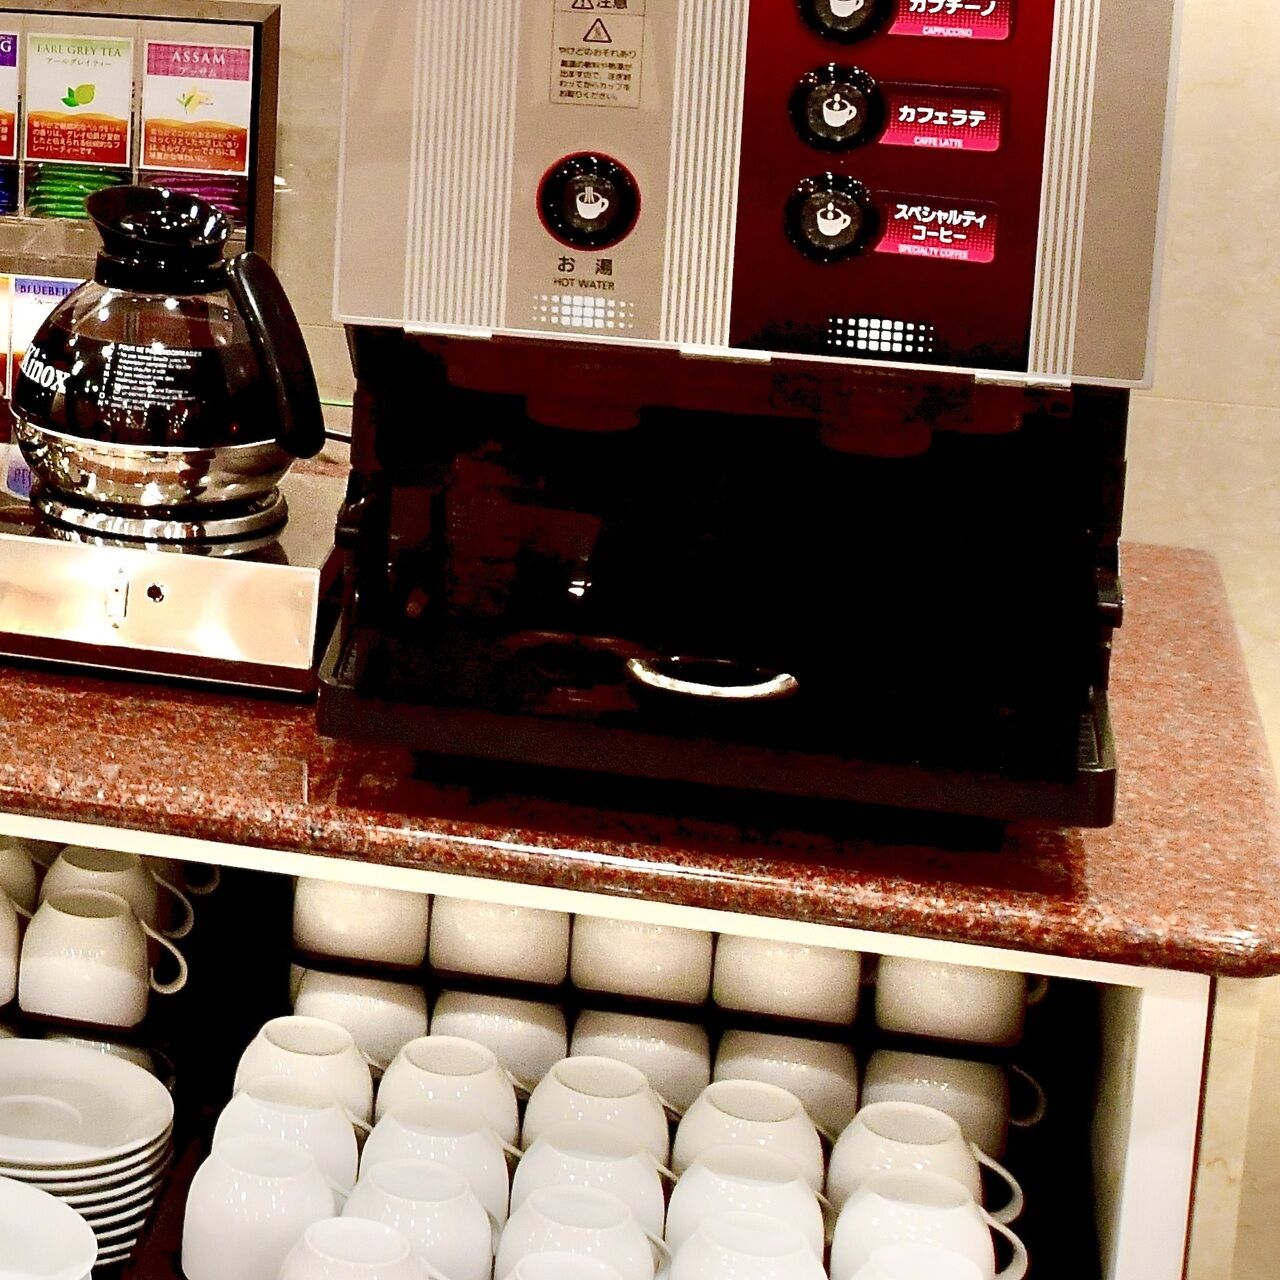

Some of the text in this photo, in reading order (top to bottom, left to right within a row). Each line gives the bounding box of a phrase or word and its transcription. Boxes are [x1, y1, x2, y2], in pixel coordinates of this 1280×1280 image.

[37, 43, 122, 58] EARL GREY TEA
[172, 50, 226, 66] ASSAM
[898, 105, 986, 127] カフェラテ
[894, 204, 987, 229] スペシャルティ
[911, 225, 967, 243] コーヒー
[558, 256, 613, 276] お湯
[554, 277, 615, 290] HOT WATER
